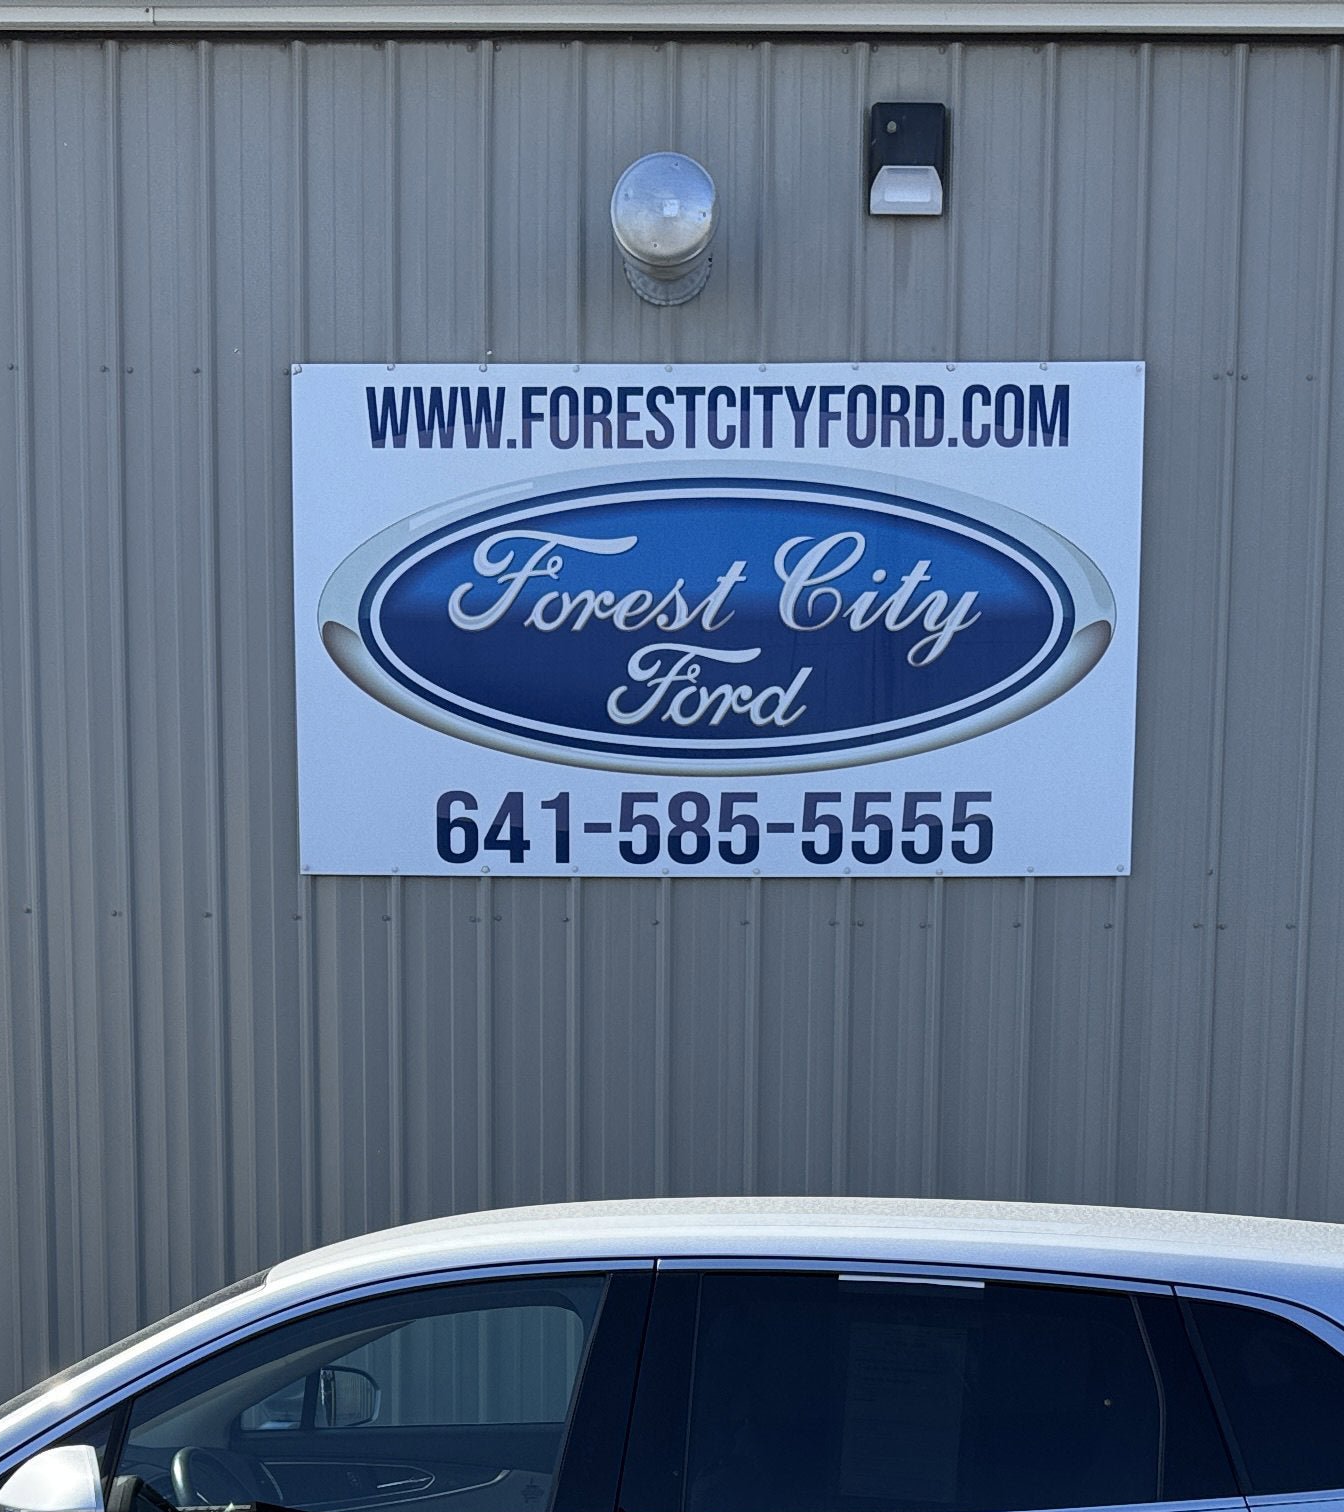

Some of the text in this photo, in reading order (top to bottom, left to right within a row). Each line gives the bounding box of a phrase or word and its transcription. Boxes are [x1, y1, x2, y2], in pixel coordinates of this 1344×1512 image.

[365, 384, 1071, 450] WWW.FORESTCITYFORD.COM
[447, 528, 983, 668] Forest City
[605, 643, 814, 728] Ford
[435, 790, 995, 866] 641-585-5555
